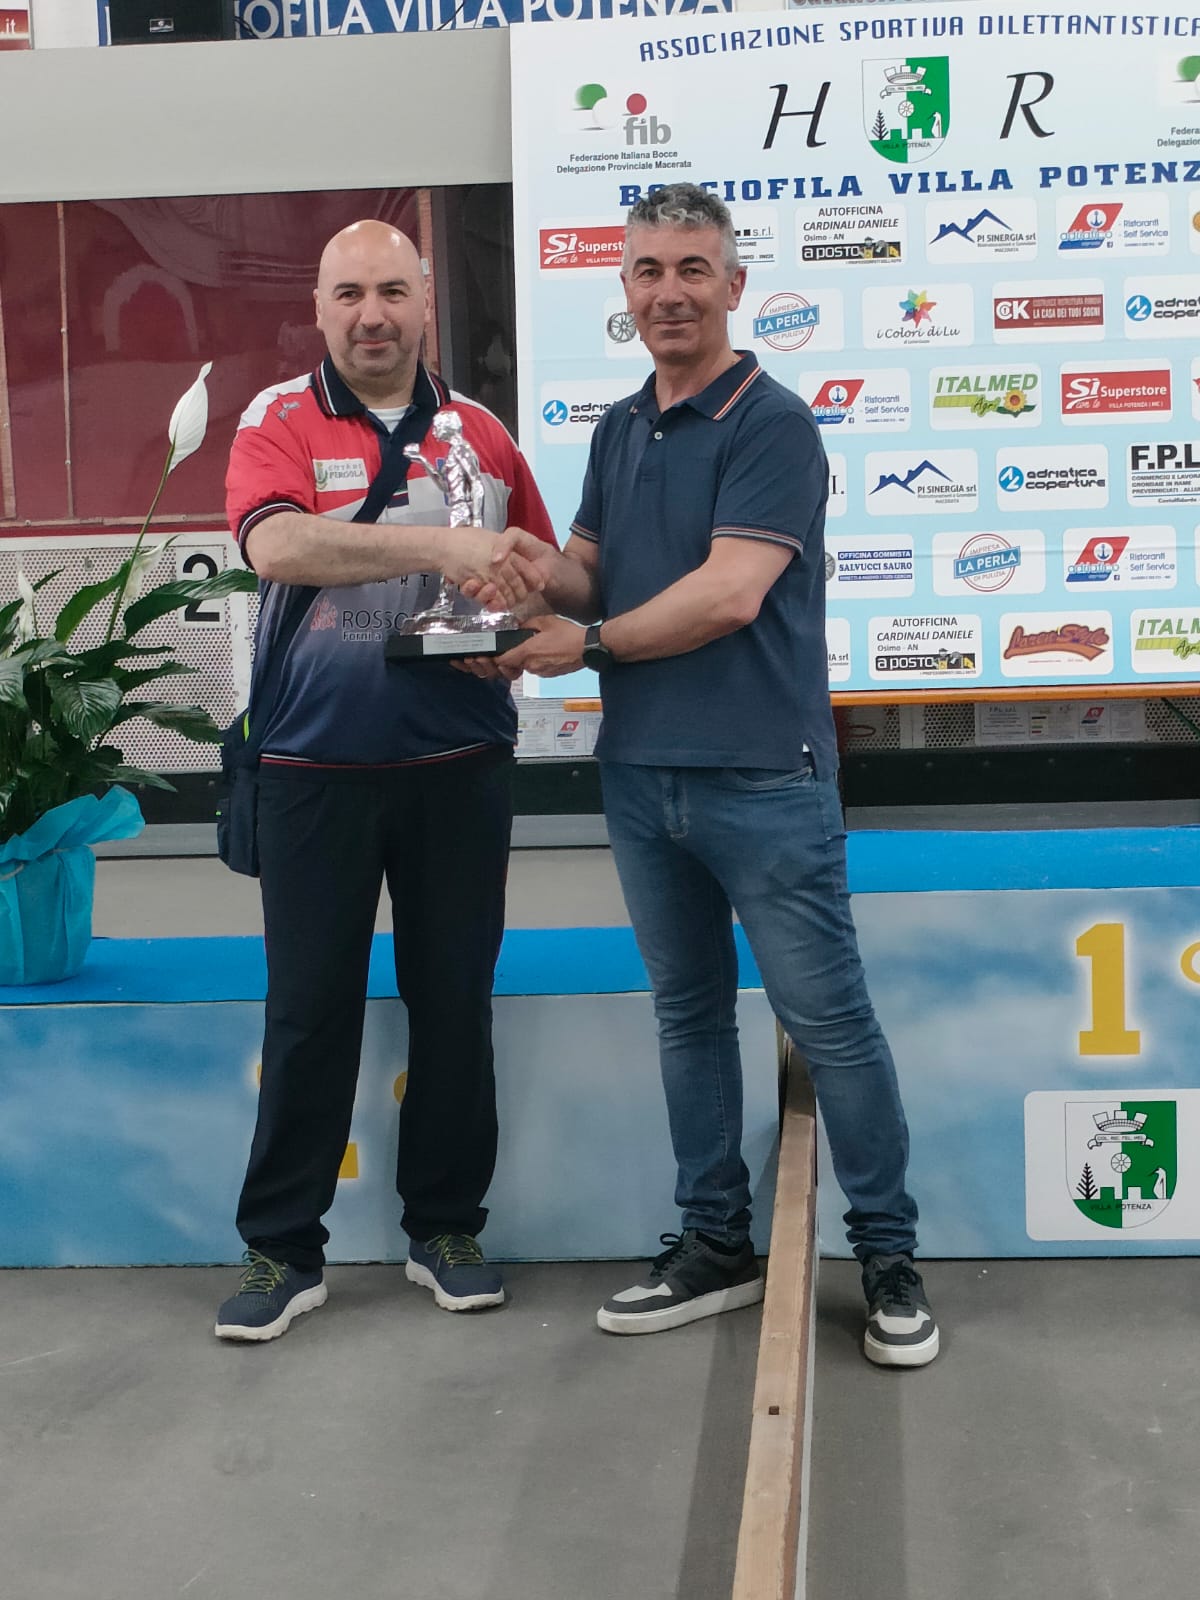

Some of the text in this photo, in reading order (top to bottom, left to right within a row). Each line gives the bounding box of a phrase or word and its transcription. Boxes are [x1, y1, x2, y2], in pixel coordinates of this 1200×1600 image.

[233, 0, 374, 40] IOFILA
[384, 0, 509, 33] VILLA
[639, 23, 825, 62] ASSOCIAZIONE
[999, 71, 1056, 140] R
[762, 81, 832, 150] H
[623, 115, 672, 146] fib
[569, 150, 678, 163] Federazione Italiana Bocce
[556, 160, 692, 174] Delegazione Provinciale Macerata
[619, 175, 863, 207] BIOFILA
[888, 168, 1014, 195] VILLA
[818, 205, 883, 217] AUTOFFICINA
[803, 218, 899, 231] CARDINALI DANIELE
[803, 233, 845, 242] Osimo AN
[976, 234, 985, 243] PI
[986, 233, 1024, 242] SINERGIA
[1123, 229, 1169, 239] Self Service
[578, 240, 626, 254] Superst
[757, 310, 816, 333] LA PERLA
[884, 326, 925, 339] Colori
[926, 325, 943, 337] di
[943, 325, 960, 337] Lu
[936, 373, 1039, 394] ITALMED
[864, 394, 900, 404] Ristoranti
[1100, 385, 1168, 400] Superstore
[864, 405, 910, 415] Self Service
[1026, 467, 1098, 479] adriatica
[917, 486, 926, 494] PI
[927, 484, 965, 494] SINERGIA
[1025, 478, 1106, 491] coperture
[839, 552, 872, 560] OFFICINA
[958, 551, 1017, 574] LA PERLA
[1129, 552, 1166, 561] Ristoranti
[838, 561, 913, 572] SALVUCCI SAURO
[1129, 562, 1175, 572] Self Service
[182, 553, 220, 622] 2
[342, 609, 412, 631] ROSSO
[892, 616, 958, 628] AUTOFFICINA
[876, 629, 974, 642] CARDINALI DANIELE
[877, 643, 919, 652] Osimo AN
